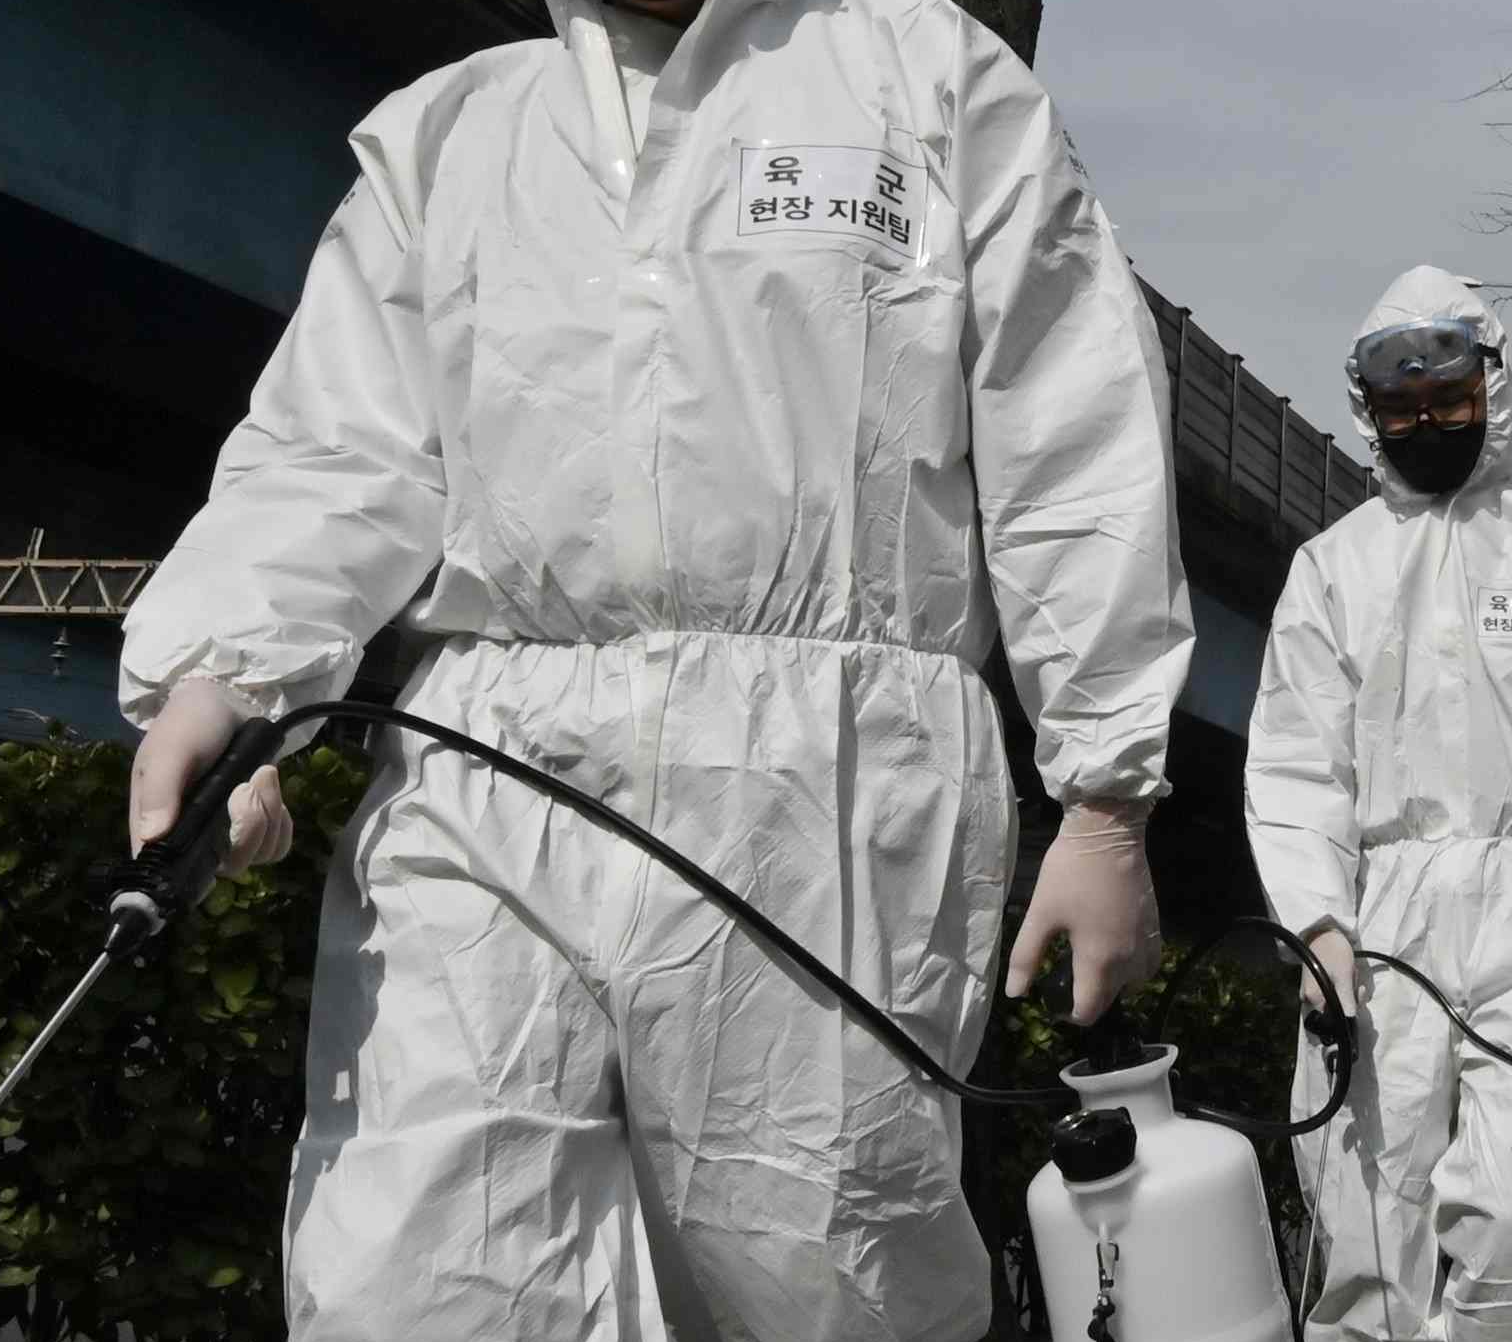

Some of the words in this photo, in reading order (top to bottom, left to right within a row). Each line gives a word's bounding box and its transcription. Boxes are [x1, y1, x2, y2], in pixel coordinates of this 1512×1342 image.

[764, 156, 803, 186] 육
[875, 163, 907, 205] 군
[749, 195, 814, 224] 현장
[827, 198, 910, 245] 지원팀
[1489, 595, 1509, 613] 육
